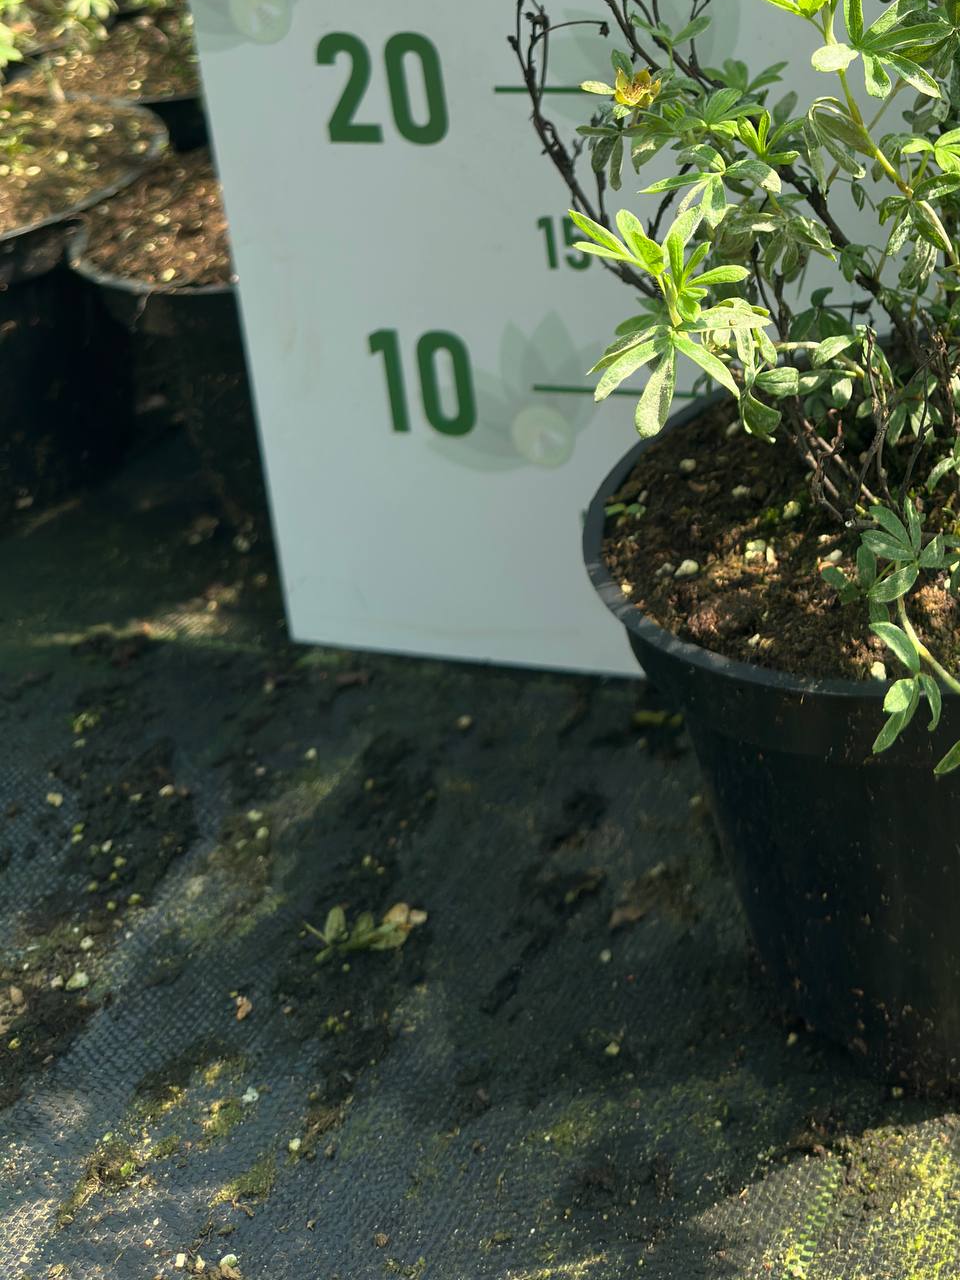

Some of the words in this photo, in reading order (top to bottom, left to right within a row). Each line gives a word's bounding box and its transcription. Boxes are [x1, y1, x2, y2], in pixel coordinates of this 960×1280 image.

[315, 31, 450, 146] 20
[536, 215, 594, 272] 15
[367, 328, 479, 440] 10
